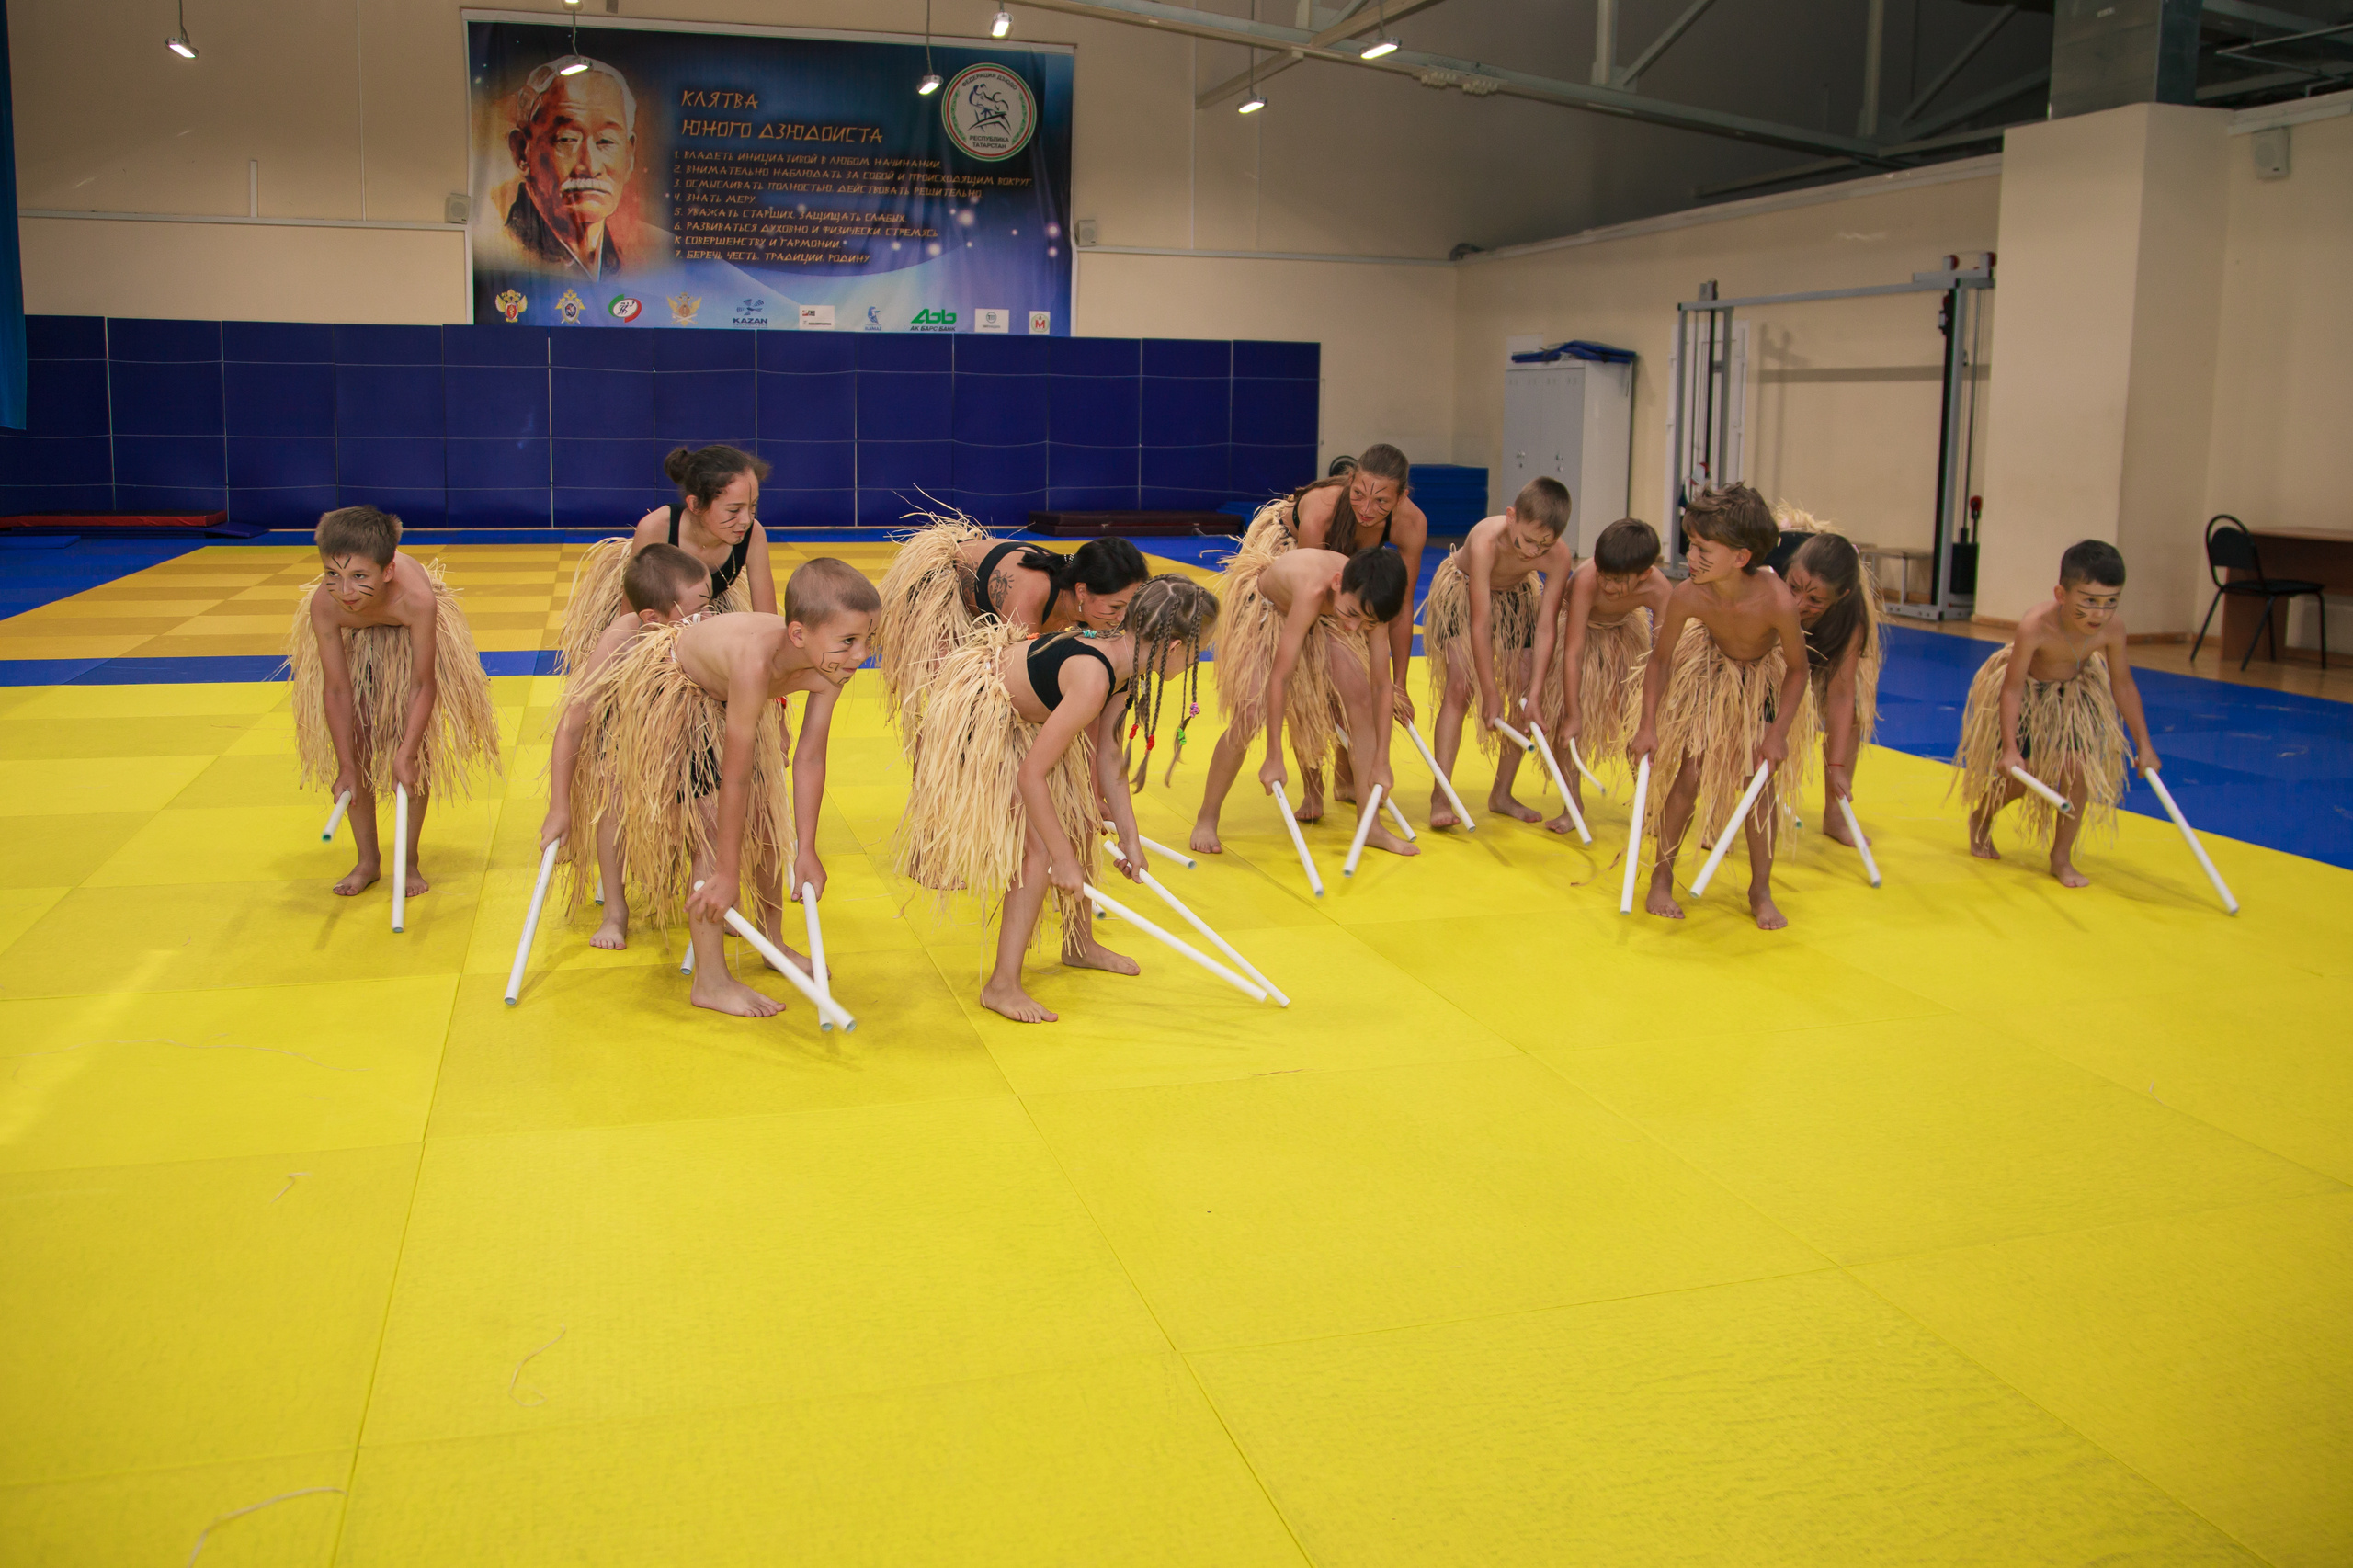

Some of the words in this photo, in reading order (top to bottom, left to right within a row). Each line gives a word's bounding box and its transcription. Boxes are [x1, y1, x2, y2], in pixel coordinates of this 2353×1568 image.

[961, 74, 996, 86] ФЕДЕРАЦИЯ
[997, 74, 1017, 89] ДЗЮДО
[681, 90, 758, 109] КЛЯТВА
[682, 119, 752, 138] ЮНОГО
[758, 123, 883, 143] ДЗЮДОИСТА
[969, 134, 1009, 143] РЕСПУБЛИКА
[972, 142, 1006, 150] ТАТАРСТАН
[684, 151, 734, 161] ВЛАДЕТЬ
[737, 153, 817, 165] ИНИЦИАТИВОЙ
[821, 154, 827, 164] В
[829, 155, 870, 166] ЛЮБОМ
[686, 165, 769, 176] ВНИМАТЕЛЬНО
[773, 167, 842, 179] НАБЛЮДАТЬ
[846, 171, 859, 179] ЗА
[863, 171, 894, 180] СОБОЙ
[897, 173, 905, 181] И
[909, 173, 994, 187] ПРОИСХОДЯЩИМ
[685, 179, 763, 190] ОСМЫСЛИВАТЬ
[837, 183, 910, 195] ДЕЙСТВОВАТЬ
[686, 193, 722, 203] ЗНАТЬ
[687, 208, 739, 218] УВАЖАТЬ
[799, 210, 861, 223] ЗАЩИЩАТЬ
[687, 222, 757, 233] РАЗВИВАТЬСЯ
[760, 223, 808, 233] ДУХОВНО
[885, 228, 938, 237] СТРЕМЯСЬ
[674, 235, 681, 244] К
[685, 236, 767, 246] СОВЕРШЕНСТВУ
[768, 238, 777, 246] И
[687, 250, 723, 259] БЕРЕЧЬ
